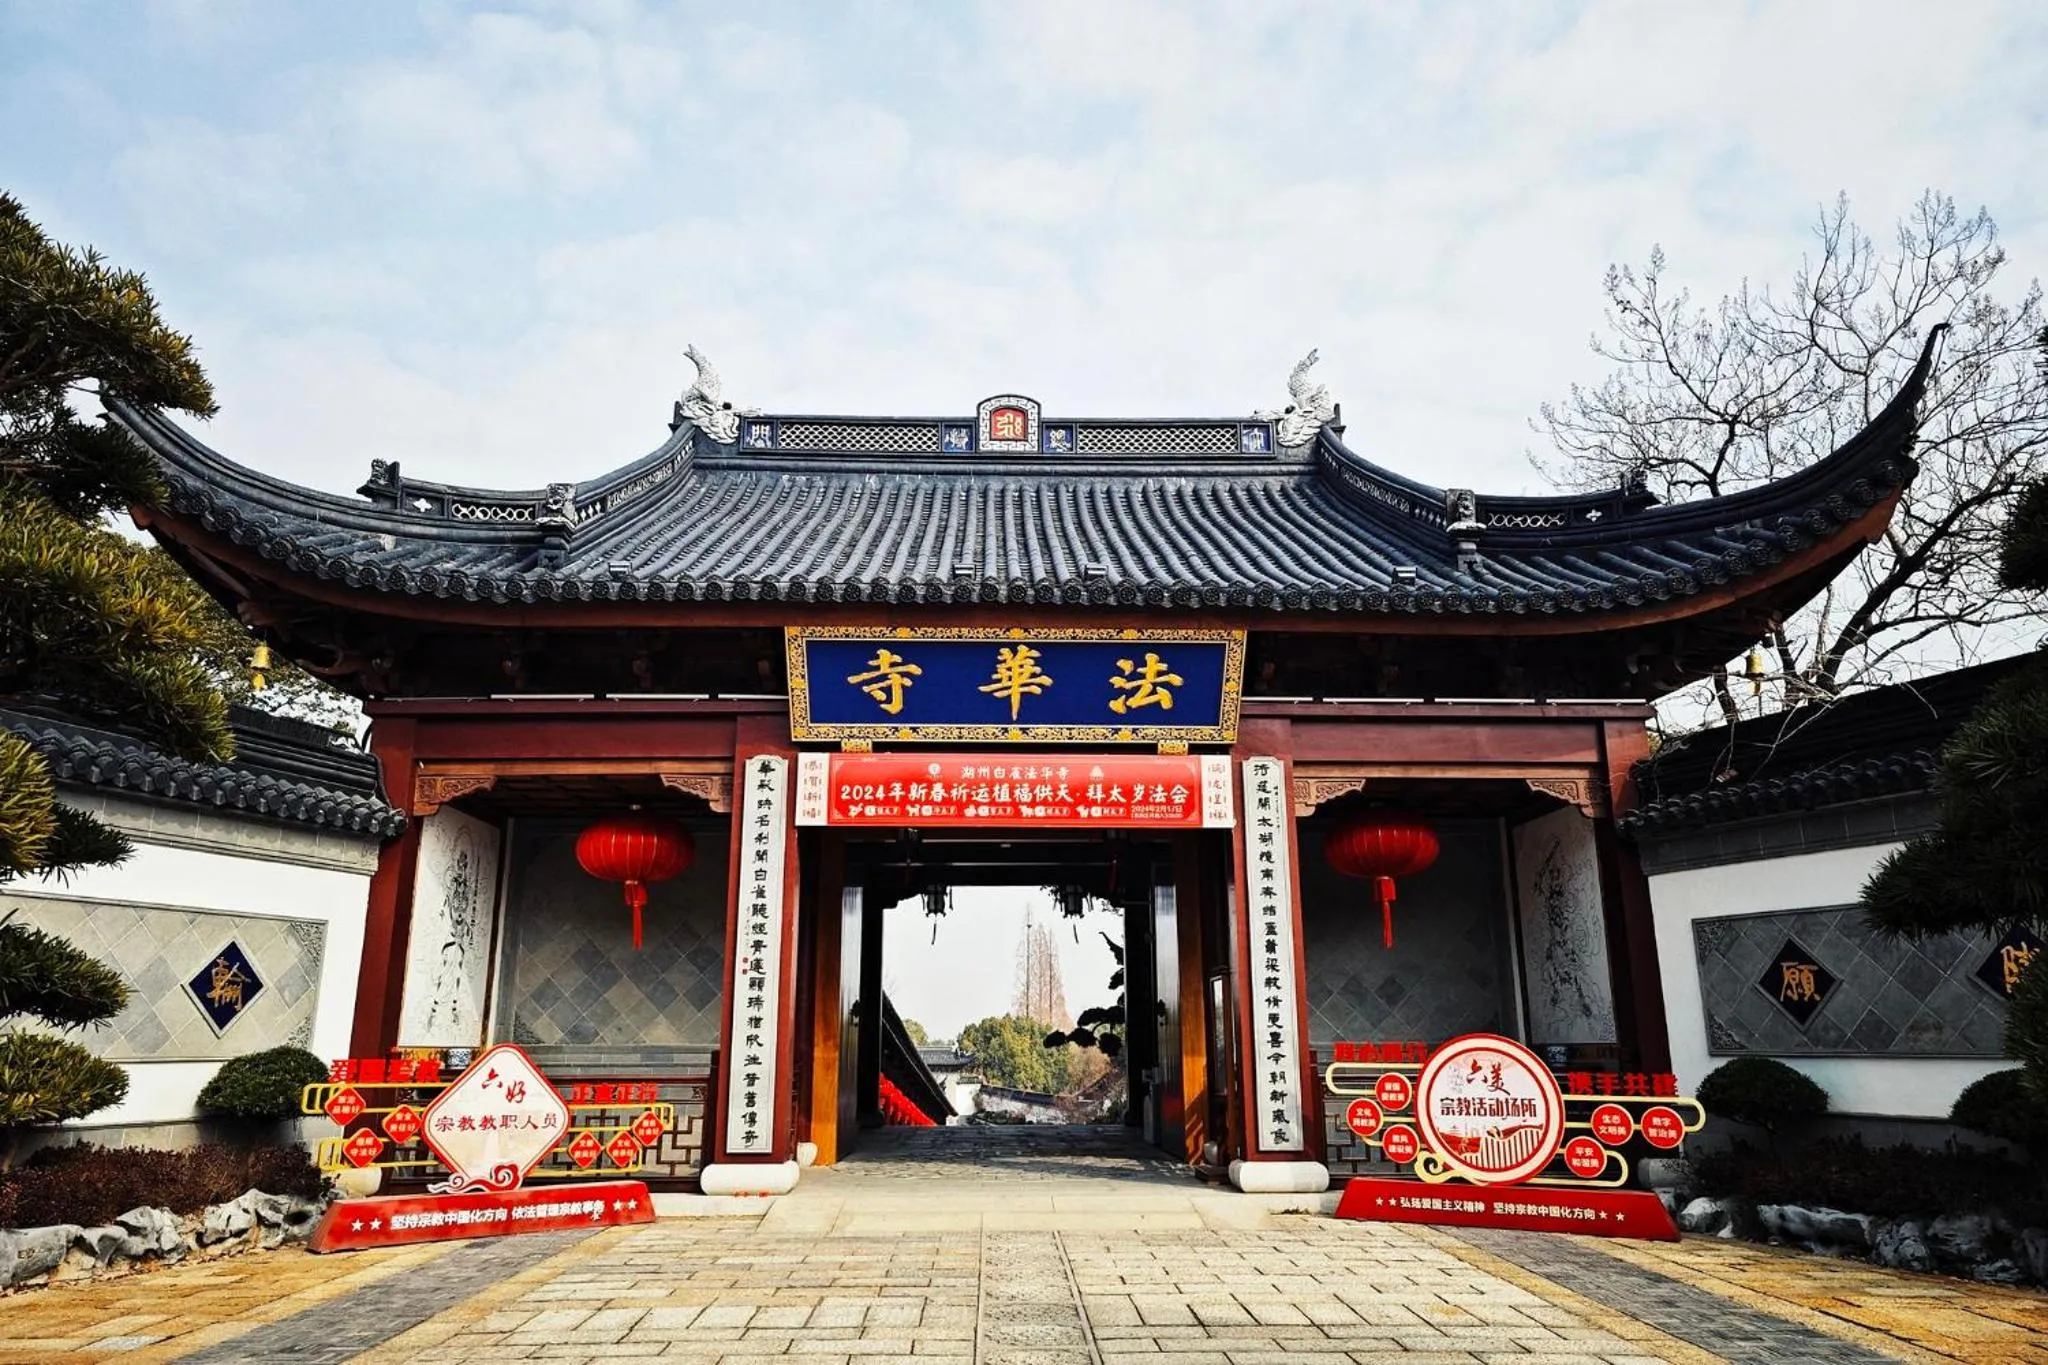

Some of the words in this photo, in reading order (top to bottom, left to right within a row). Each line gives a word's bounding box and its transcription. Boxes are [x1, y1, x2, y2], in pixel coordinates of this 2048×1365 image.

[847, 644, 1184, 721] 法華寺
[961, 765, 1070, 780] 湖州白雀法华寺
[1567, 1072, 1678, 1097] 携手共建
[1440, 1097, 1537, 1119] 宗教活动场所
[435, 1113, 557, 1132] 宗教教职人员
[390, 1207, 508, 1230] 坚持宗教中国化方向
[512, 1200, 604, 1221] 依法管理宗教事务
[1400, 1196, 1485, 1214] 弘扬爱国主义精神
[1493, 1201, 1596, 1220] 坚持宗教中国化方向
